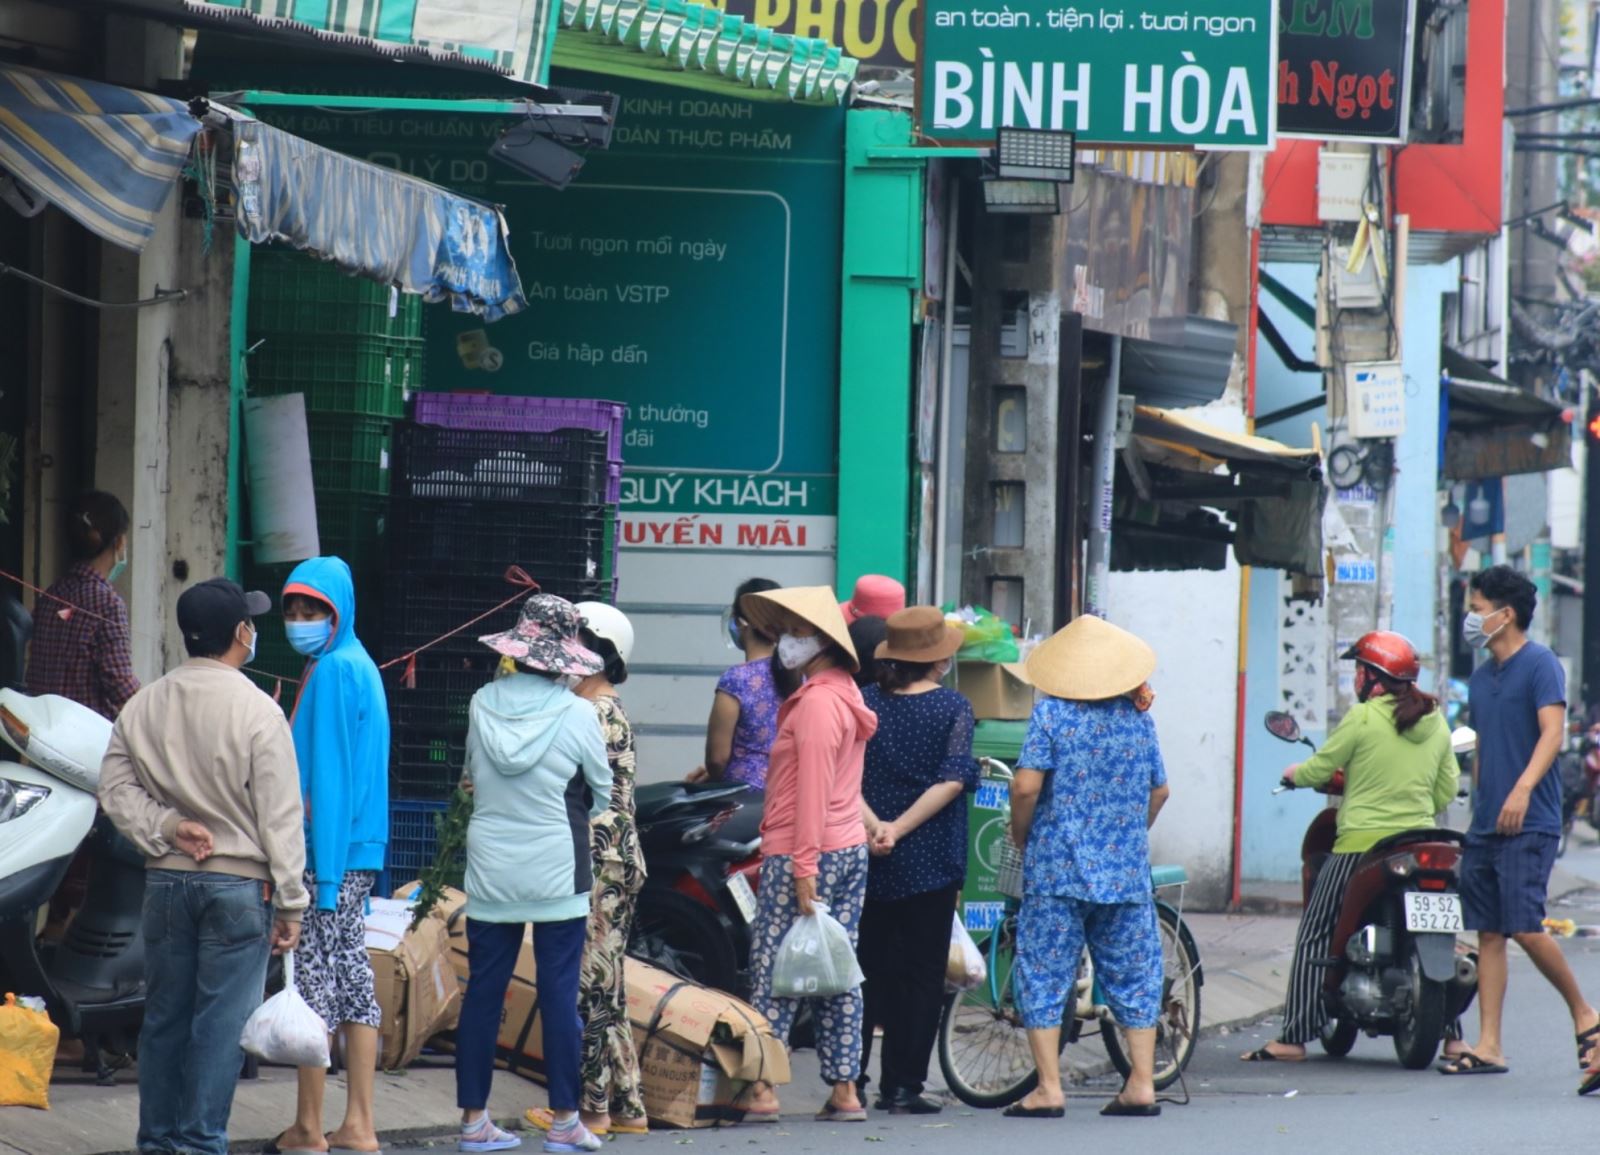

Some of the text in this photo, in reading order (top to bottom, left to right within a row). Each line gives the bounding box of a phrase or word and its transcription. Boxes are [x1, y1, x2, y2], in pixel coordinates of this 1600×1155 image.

[935, 10, 966, 28] an
[972, 6, 1030, 28] toàn
[1046, 8, 1094, 32] tiện
[1099, 8, 1124, 33] lợi
[1194, 15, 1256, 36] ngon
[933, 47, 1091, 131] BÌNH
[1123, 50, 1257, 135] HÒA
[1309, 60, 1395, 119] Ngọt
[623, 98, 752, 120] KINH DOANH
[612, 125, 660, 144] OÀN
[667, 129, 723, 149] THỰC
[451, 160, 488, 182] DO
[580, 238, 629, 257] ngon
[680, 238, 727, 262] ngày
[529, 281, 671, 304] An toàn VSTP
[529, 340, 560, 361] Giá
[640, 403, 708, 428] thưởng
[625, 428, 654, 447] đãi
[619, 473, 807, 507] QUÝ KHÁCH
[624, 514, 807, 547] UYẾN MÃI
